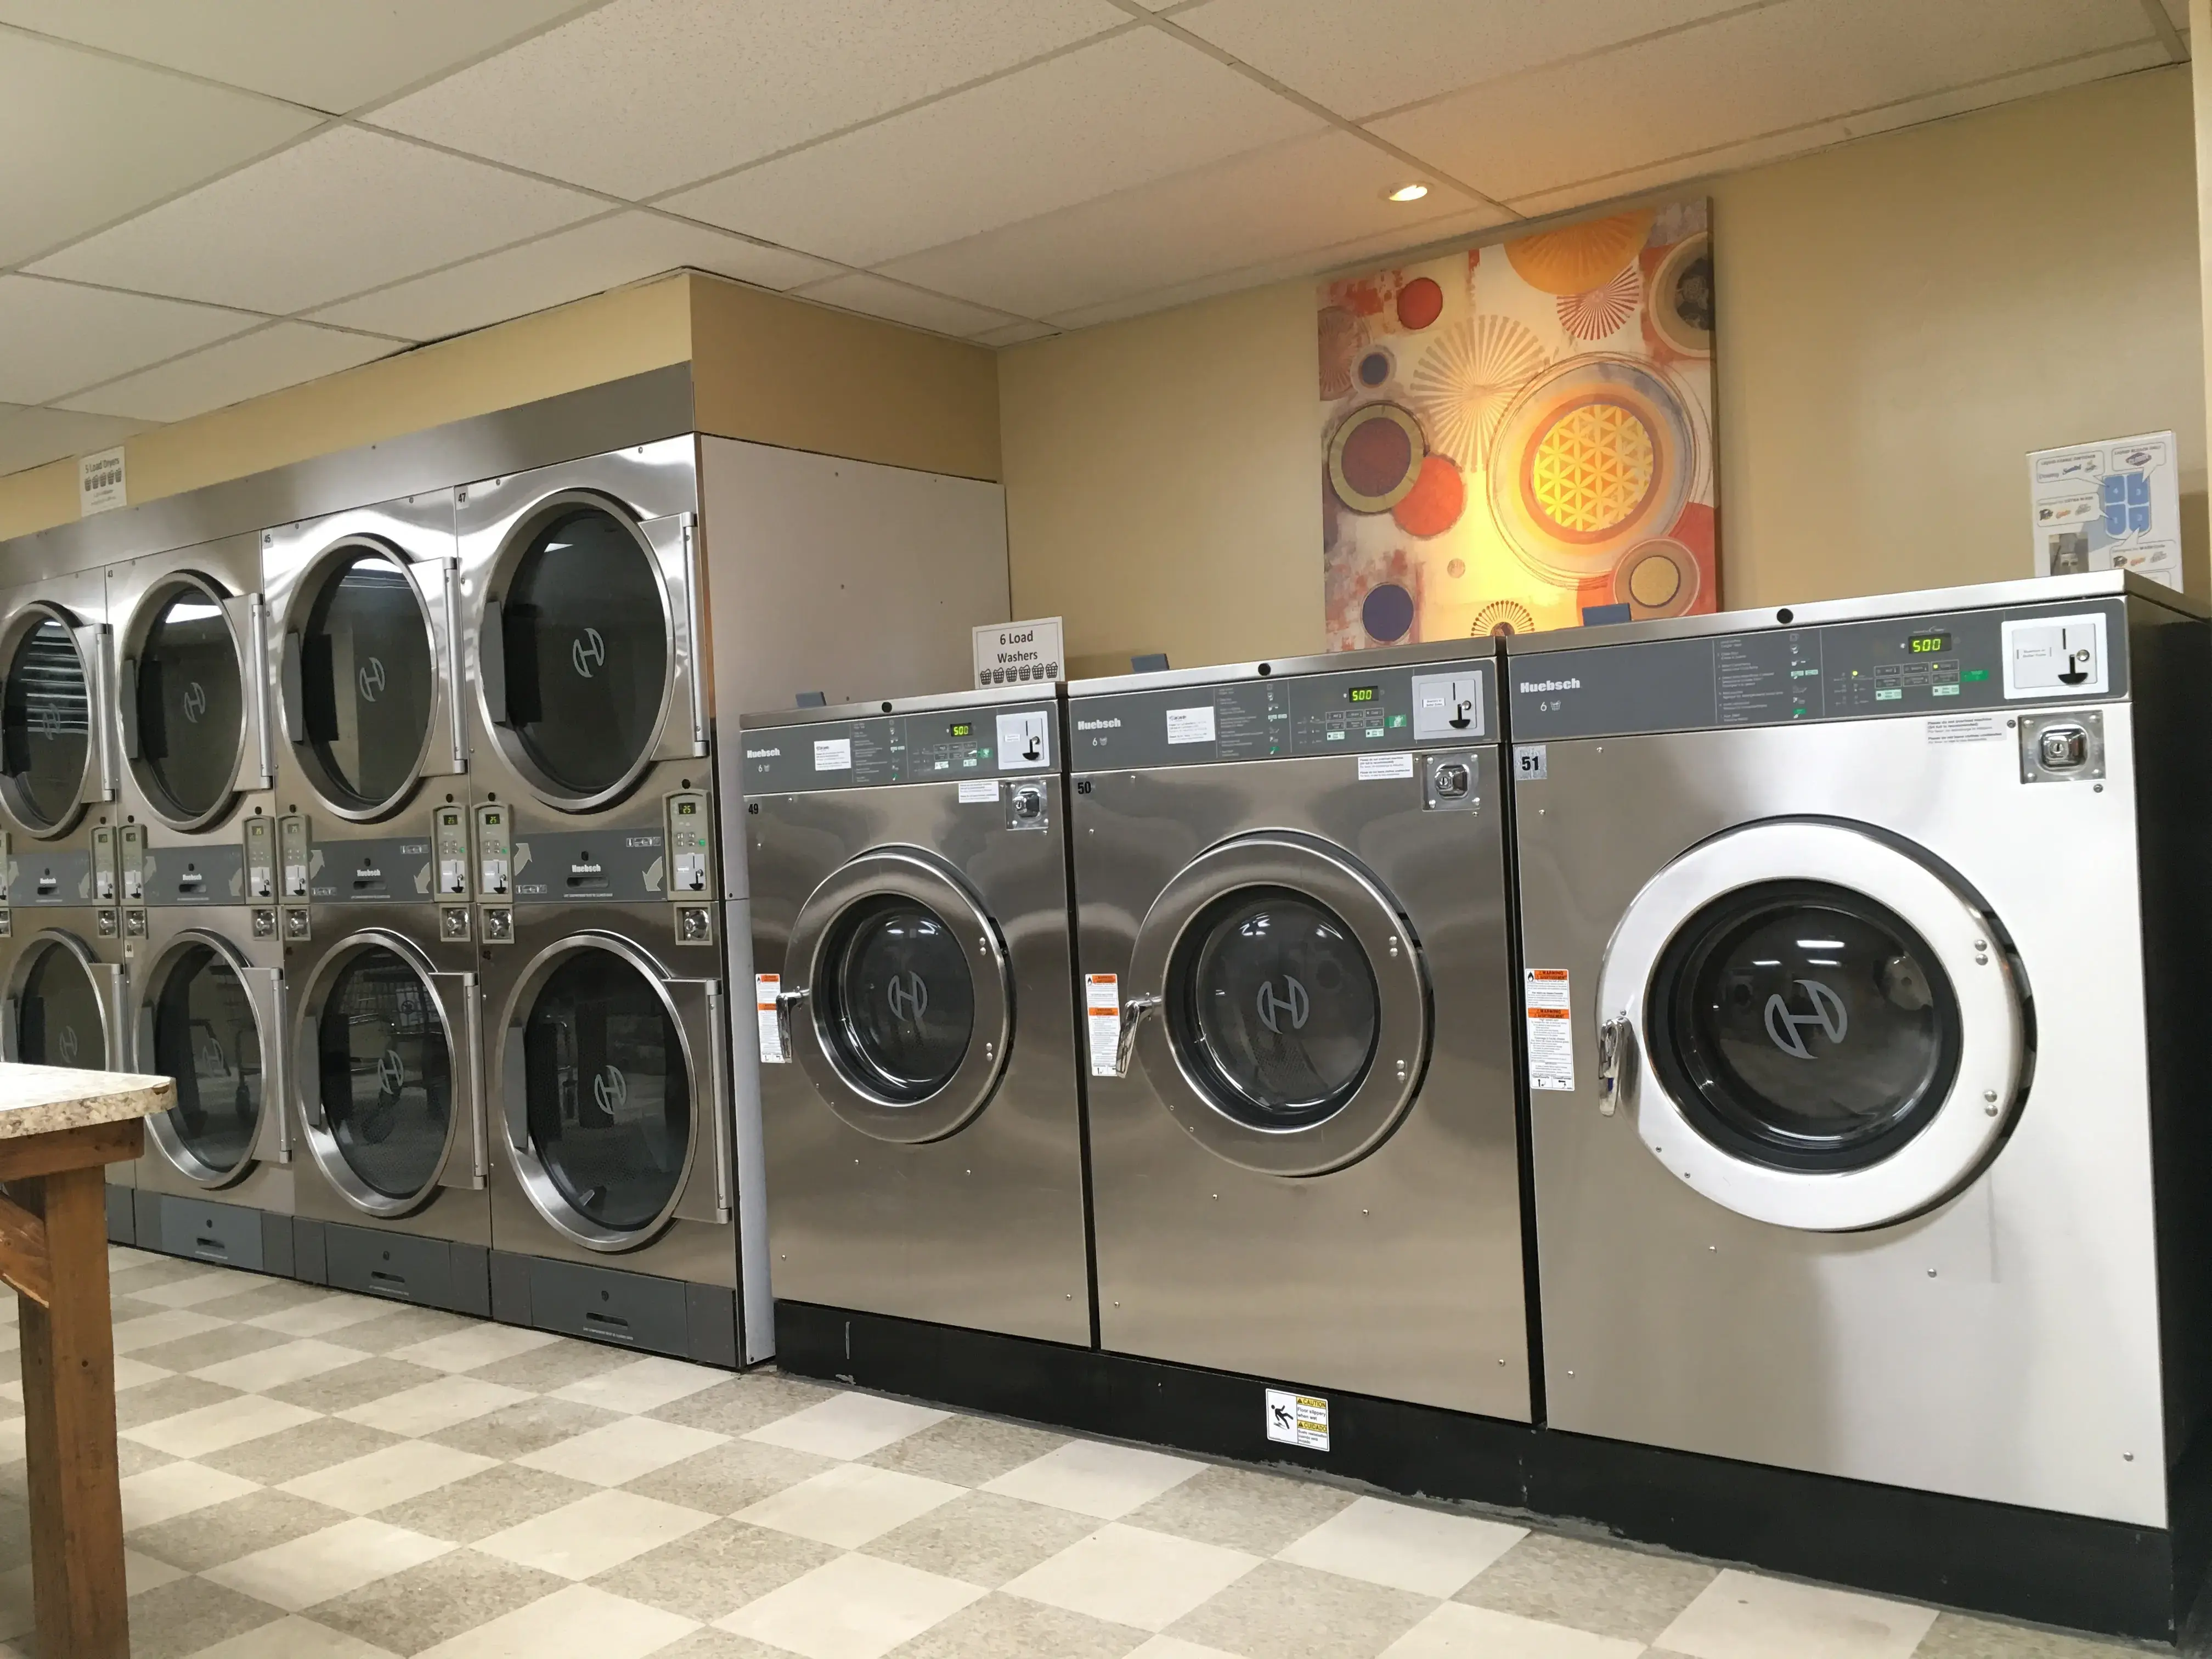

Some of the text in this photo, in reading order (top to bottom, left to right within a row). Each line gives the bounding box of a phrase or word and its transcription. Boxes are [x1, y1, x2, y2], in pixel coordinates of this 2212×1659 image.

[459, 493, 466, 503] 47
[264, 534, 271, 543] 45
[1000, 630, 1033, 645] 6 Load
[1912, 639, 1941, 652] 500
[997, 651, 1038, 663] Washers
[1520, 678, 1581, 693] Huebsch
[1353, 690, 1372, 701] 500
[1541, 702, 1547, 711] 6
[1077, 718, 1121, 730] Huebsch
[953, 725, 969, 735] 500
[1092, 737, 1098, 746] 6
[747, 748, 781, 758] Huebsch
[1522, 756, 1539, 771] 51
[1077, 781, 1092, 794] 50
[748, 803, 759, 814] 49
[572, 864, 601, 872] Huebsch
[1304, 1399, 1325, 1408] CAUTION
[1304, 1422, 1327, 1432] CUIDADO
